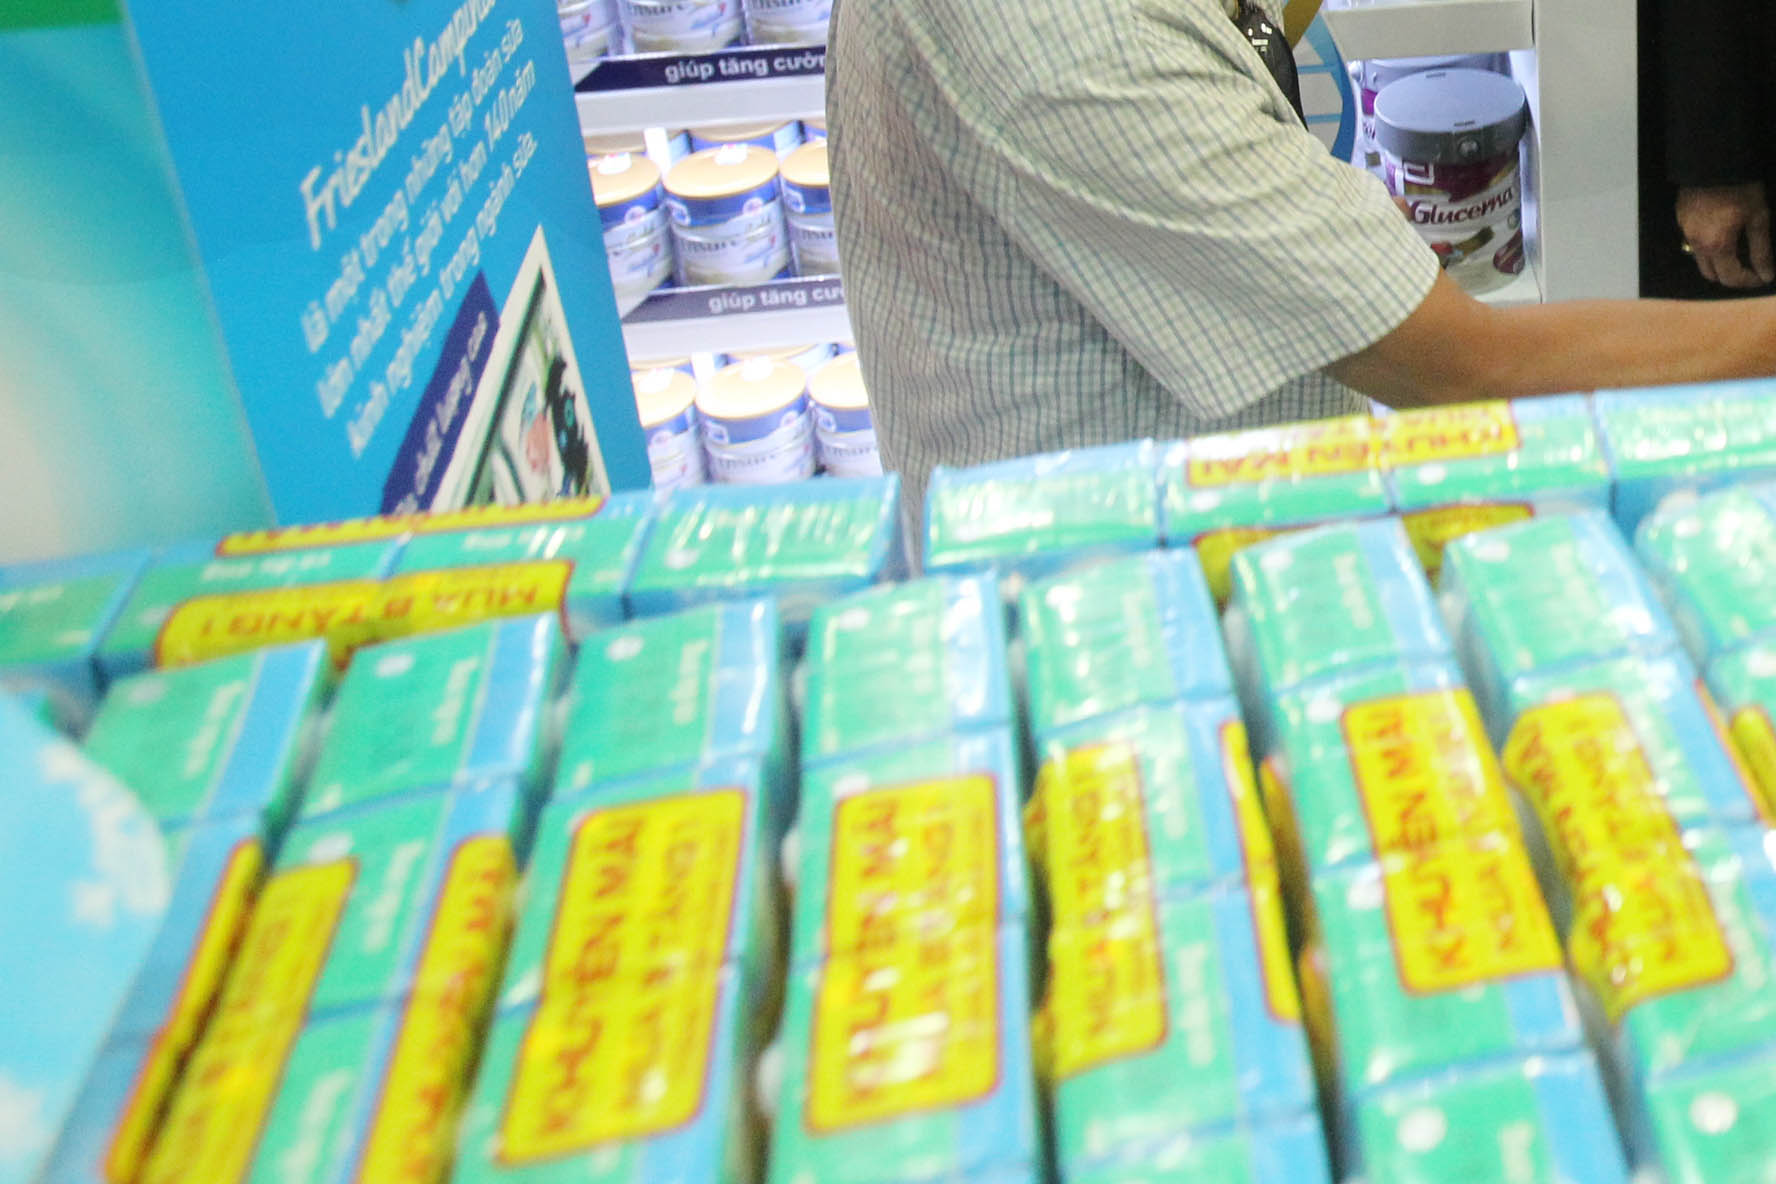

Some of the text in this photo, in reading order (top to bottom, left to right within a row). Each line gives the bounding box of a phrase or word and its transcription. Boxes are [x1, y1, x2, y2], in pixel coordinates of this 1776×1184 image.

[665, 53, 827, 84] giúp tăng cườ
[485, 89, 509, 152] 140
[360, 189, 409, 268] trong
[1409, 187, 1514, 224] Glucerna
[439, 225, 480, 299] trong
[709, 292, 755, 313] giúp
[760, 288, 807, 310] tăng
